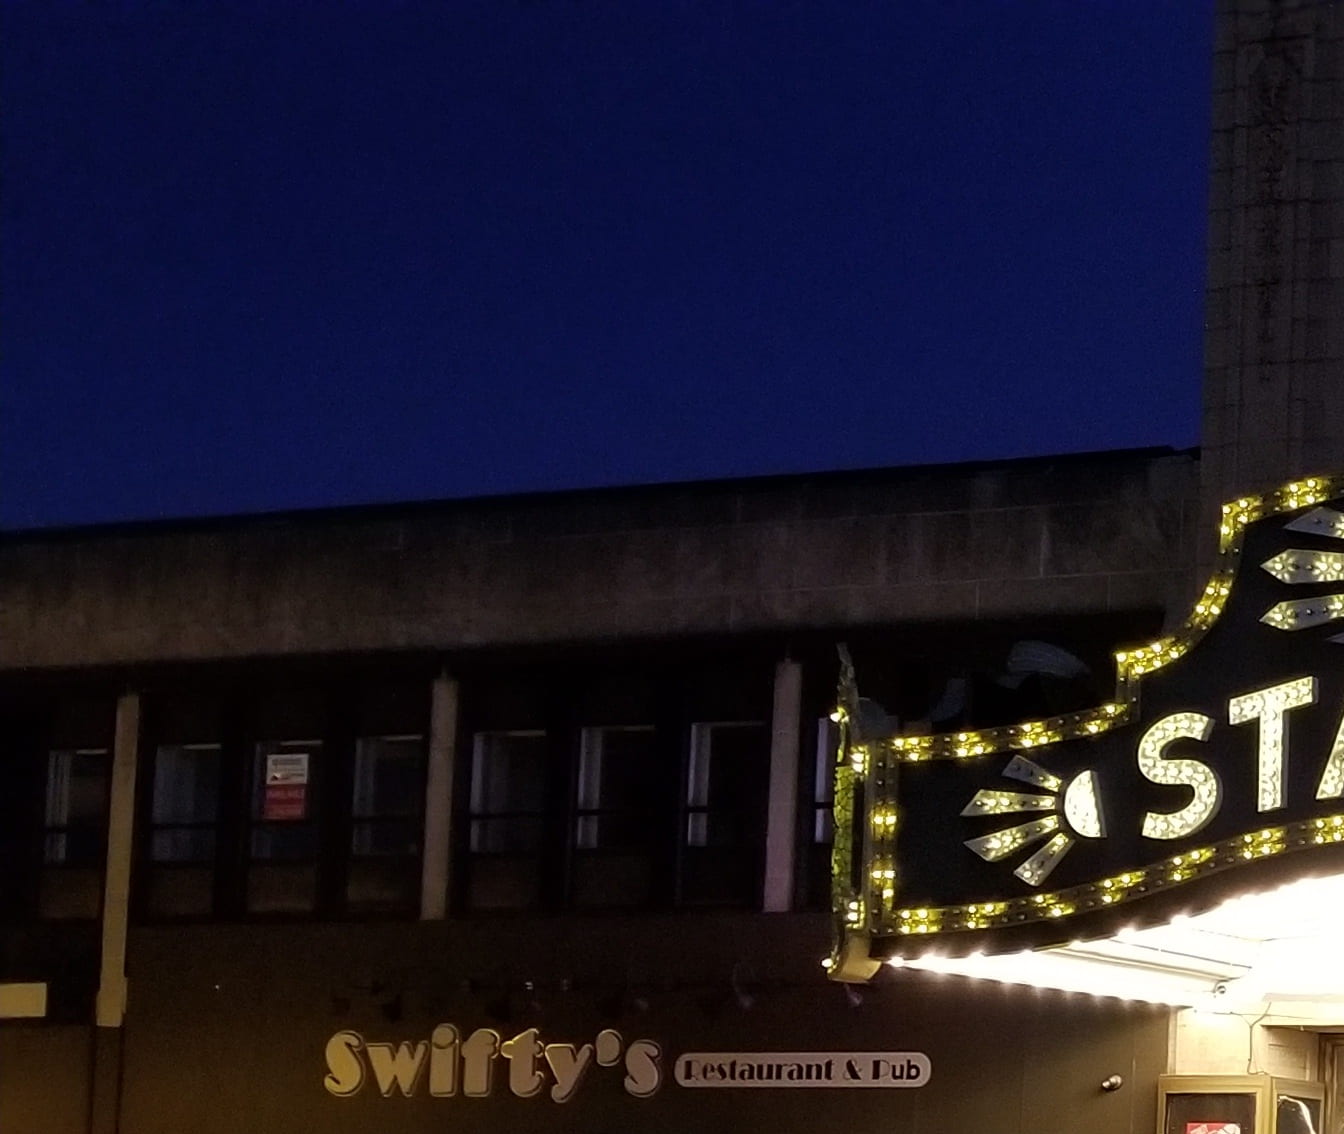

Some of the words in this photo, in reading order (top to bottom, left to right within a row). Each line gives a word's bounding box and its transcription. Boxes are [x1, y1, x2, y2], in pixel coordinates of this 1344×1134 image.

[324, 1023, 663, 1103] Swifty's
[684, 1059, 834, 1081] Restaurant
[844, 1059, 863, 1081] &
[871, 1058, 921, 1081] Pub
